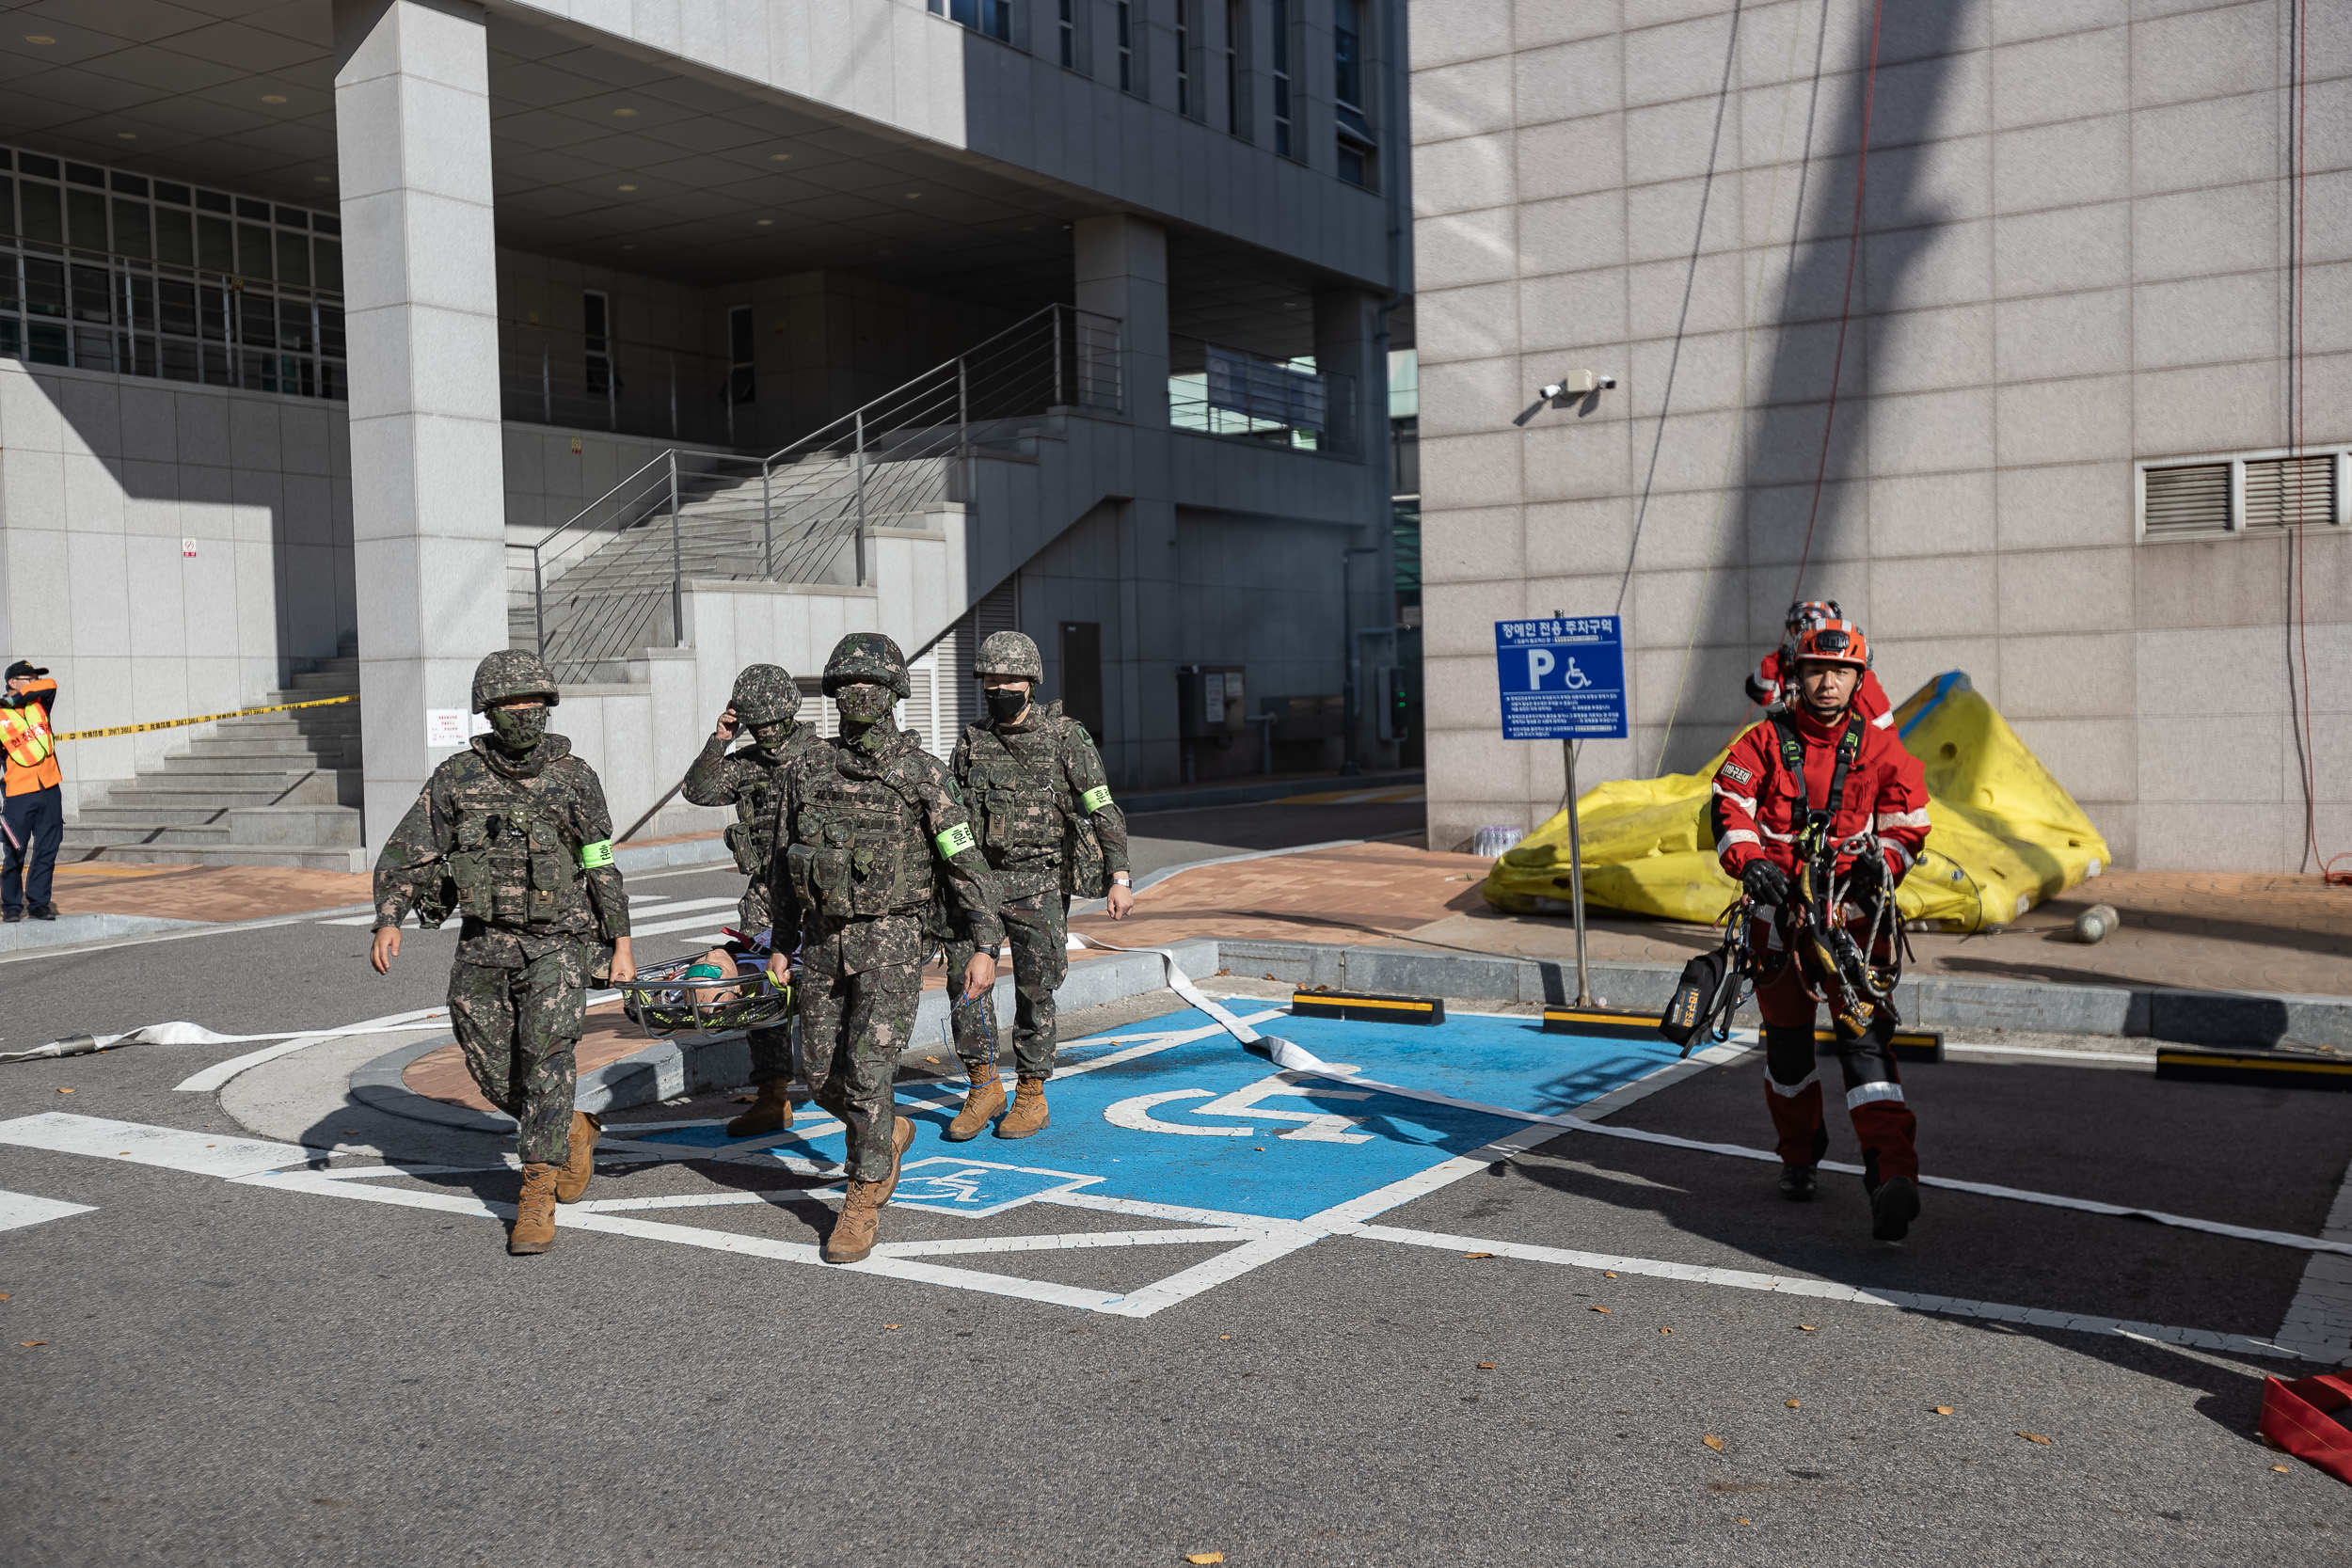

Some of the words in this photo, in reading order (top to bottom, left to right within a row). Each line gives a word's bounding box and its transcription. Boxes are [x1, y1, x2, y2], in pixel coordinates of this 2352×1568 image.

[1502, 623, 1536, 639] 장애인
[1539, 621, 1562, 637] 전용
[1565, 619, 1613, 635] 주차구역
[1528, 649, 1555, 690] P
